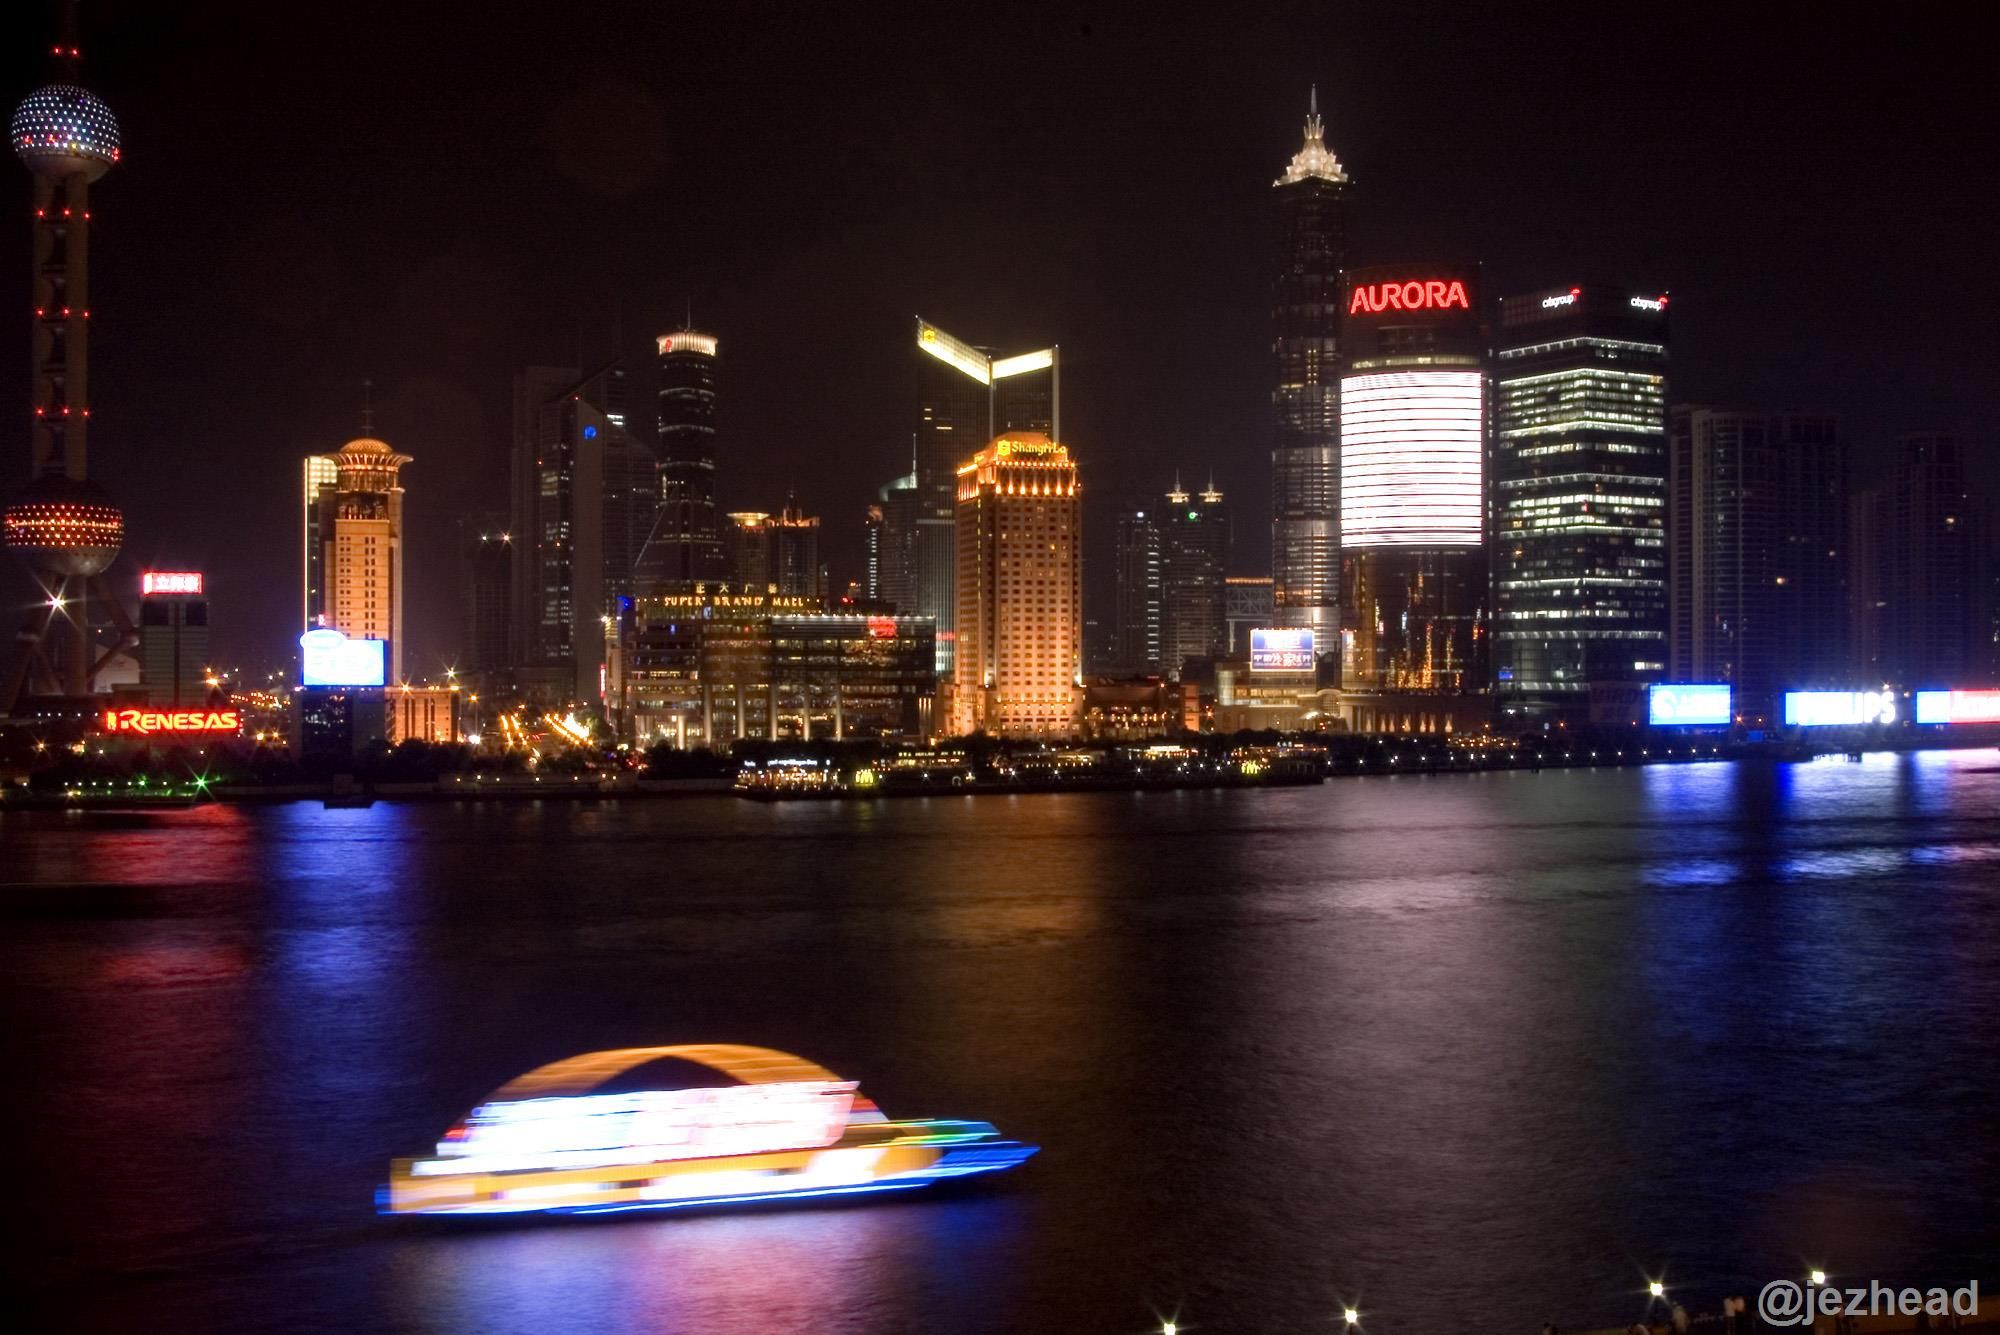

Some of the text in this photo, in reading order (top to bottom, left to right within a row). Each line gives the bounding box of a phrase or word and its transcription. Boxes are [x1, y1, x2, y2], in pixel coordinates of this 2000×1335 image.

[1350, 281, 1469, 314] AURORA
[664, 597, 703, 606] SUPER
[714, 597, 763, 606] BRAND
[120, 709, 238, 734] RENESAS
